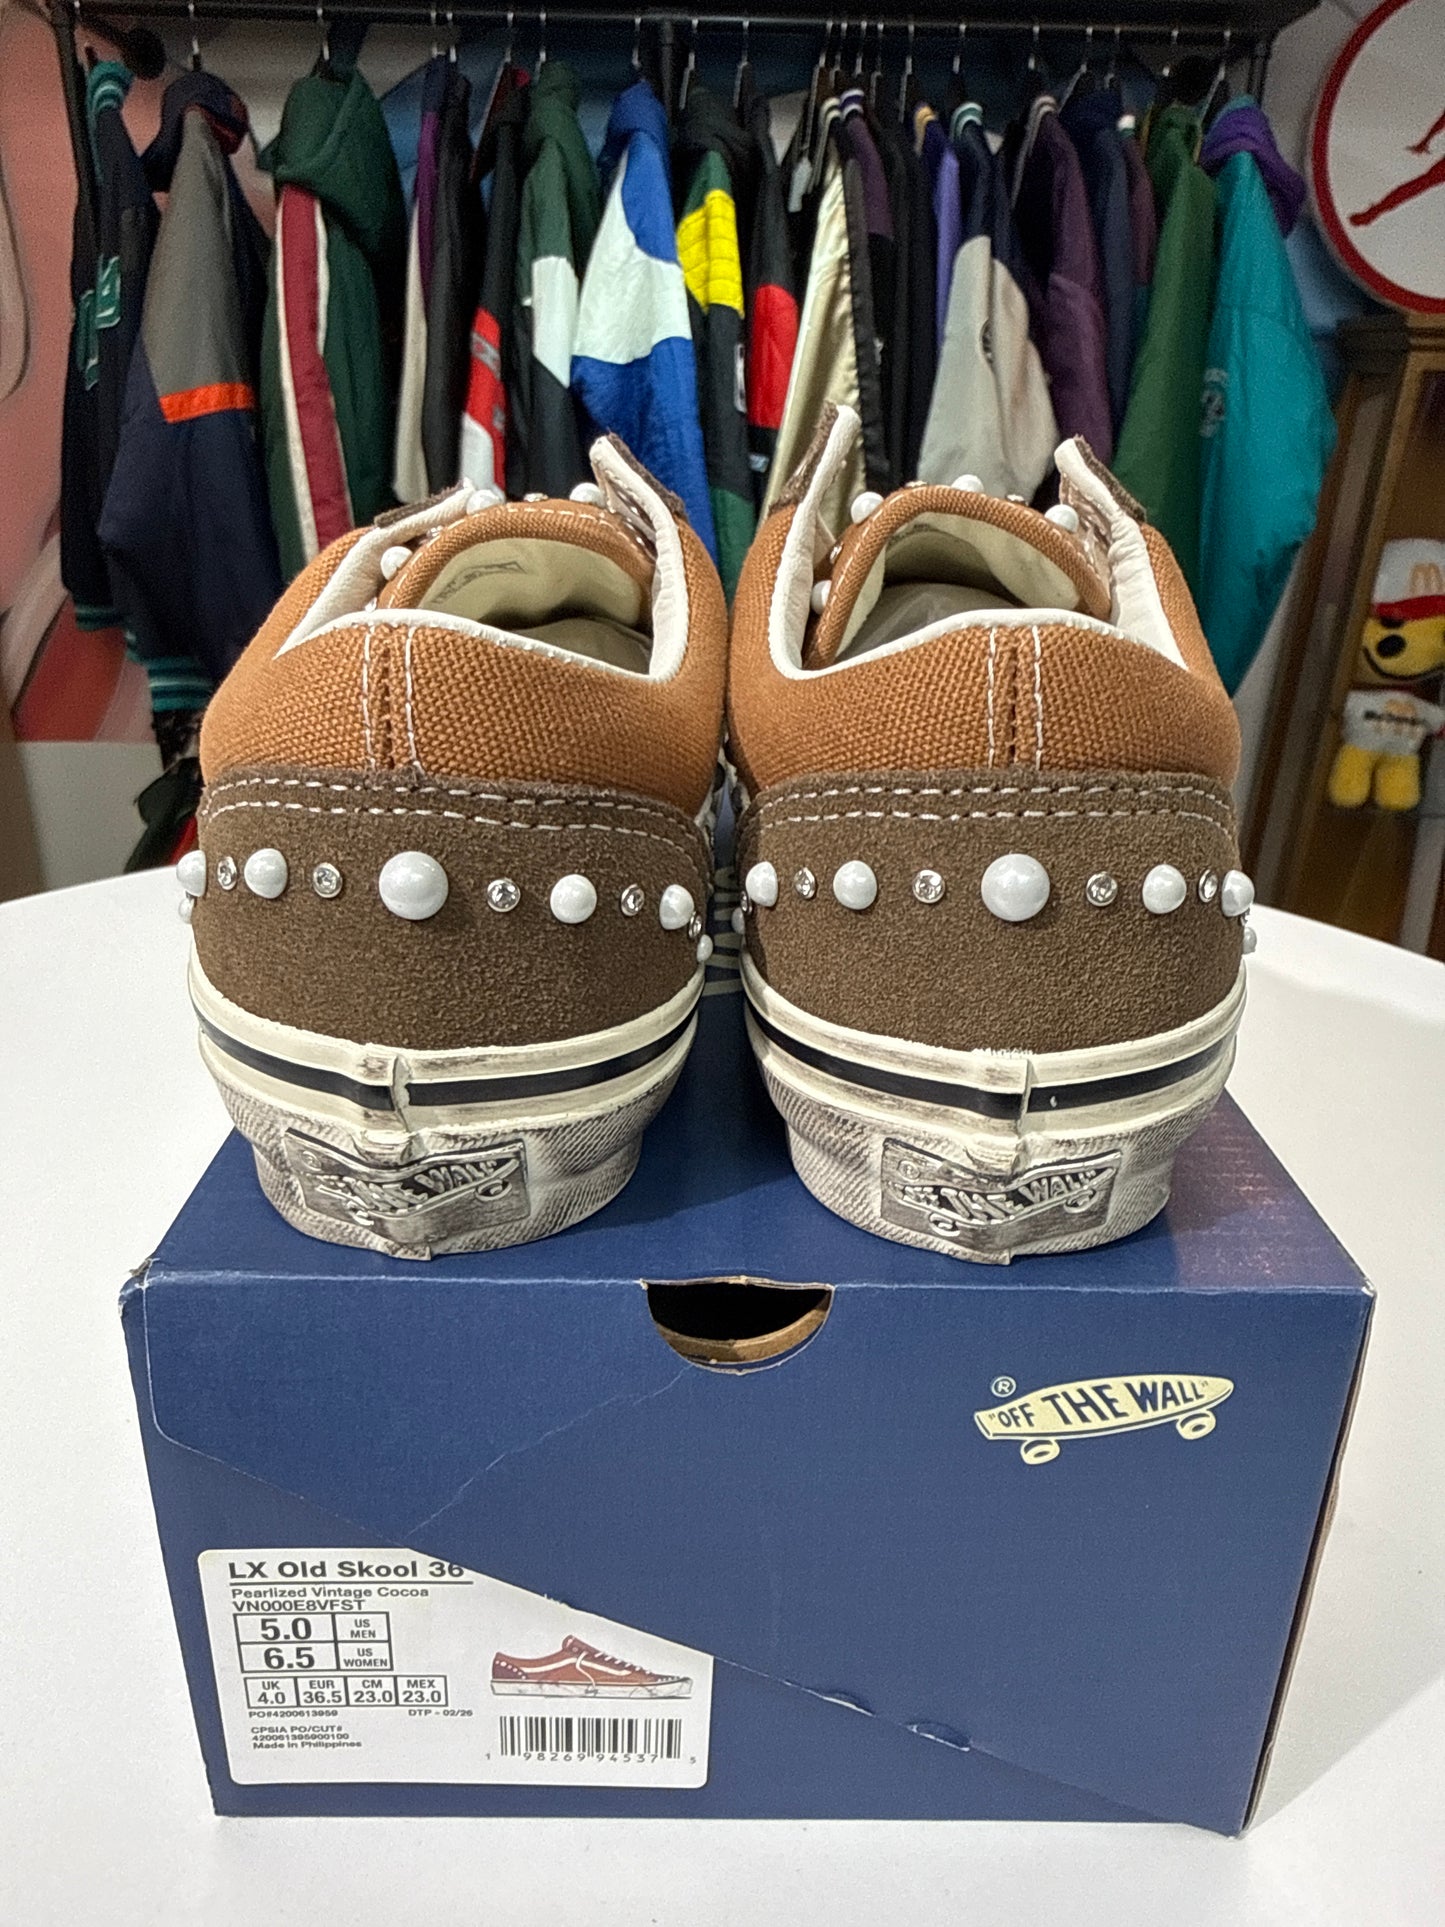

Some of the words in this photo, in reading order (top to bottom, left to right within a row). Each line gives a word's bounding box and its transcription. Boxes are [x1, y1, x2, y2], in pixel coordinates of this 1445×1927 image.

[1041, 1384, 1129, 1425] THE
[228, 1561, 269, 1579] LX
[277, 1560, 327, 1578] Old
[337, 1560, 418, 1578] Skool
[428, 1561, 464, 1578] 36
[231, 1587, 307, 1599] Pearlized
[311, 1586, 373, 1599] Vintage
[377, 1586, 429, 1597] Cocoa
[232, 1599, 366, 1612] VN000E8VFST
[260, 1617, 312, 1641] 5.0
[354, 1618, 371, 1628] US
[350, 1629, 376, 1639] MEN
[263, 1646, 316, 1670] 6.5
[356, 1648, 373, 1657] US
[343, 1658, 388, 1668] WOMEN
[261, 1680, 280, 1691] UK
[309, 1679, 335, 1690] EUR
[361, 1679, 383, 1689] CM
[406, 1678, 436, 1689] MEX
[257, 1691, 286, 1705] 4.0
[302, 1690, 343, 1704] 36.5
[352, 1690, 393, 1703] 23.0
[402, 1690, 442, 1703] 23.0
[407, 1708, 432, 1717] DTP
[442, 1708, 473, 1717] 02/26
[250, 1726, 288, 1734] CPSIA
[290, 1725, 343, 1733] PO/CUT#
[301, 1741, 363, 1749] Philippines
